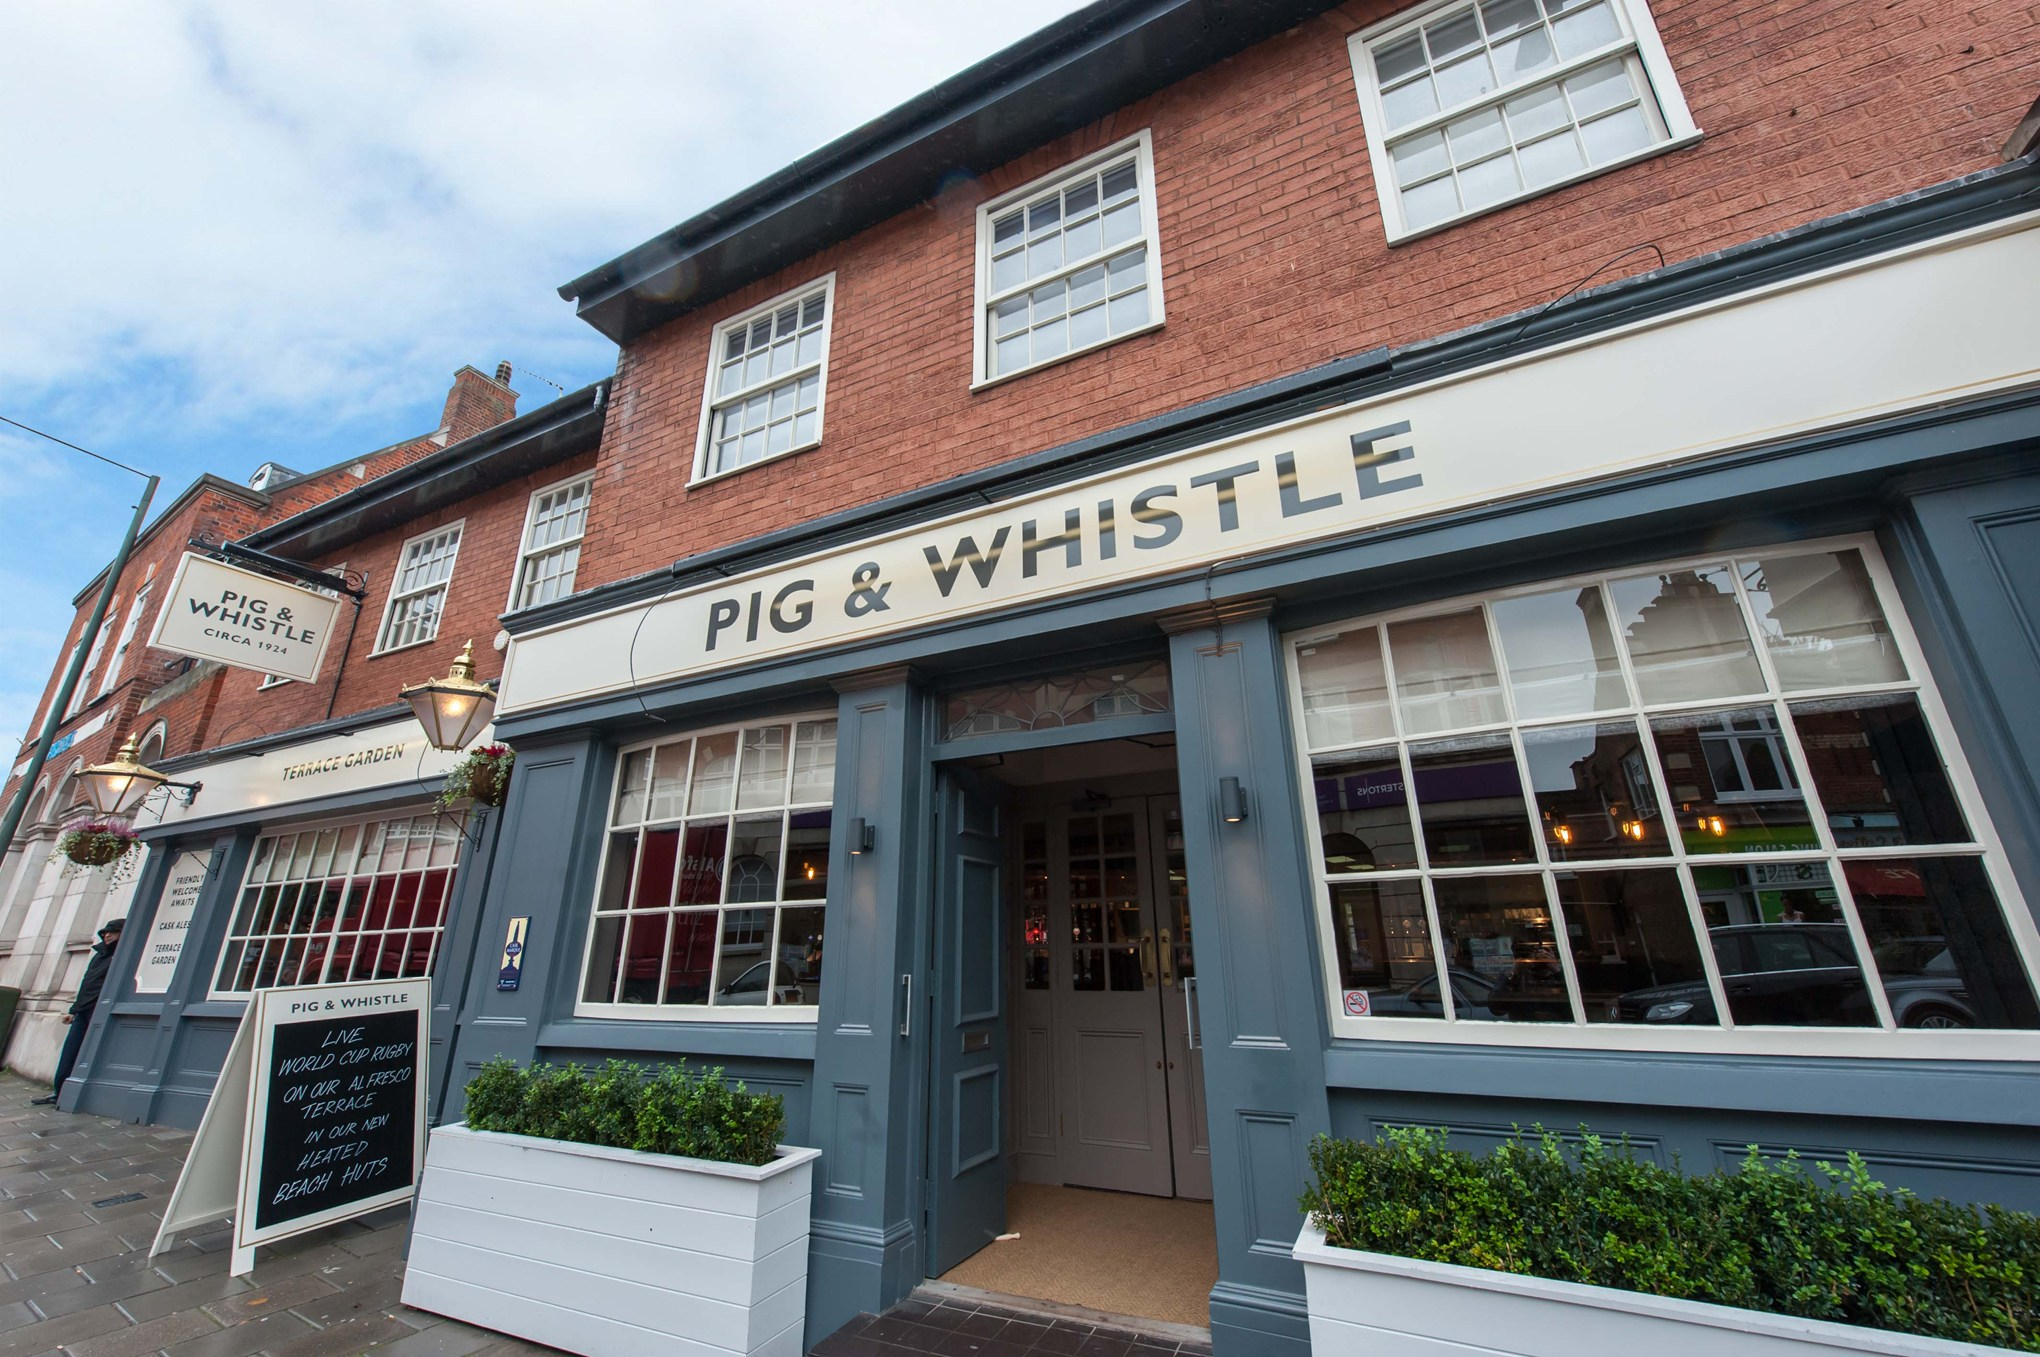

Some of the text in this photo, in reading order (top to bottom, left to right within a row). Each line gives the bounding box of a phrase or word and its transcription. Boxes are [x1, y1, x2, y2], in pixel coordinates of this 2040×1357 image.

[704, 418, 1425, 652] PIG & WHISTLE
[220, 590, 295, 622] PIG &
[189, 598, 316, 645] WHISTLE
[203, 628, 287, 655] CIRCA 1924
[282, 743, 406, 781] TERRACE GARDEN
[172, 887, 202, 896] WELCOME
[176, 875, 205, 885] FRIENDLY
[171, 898, 195, 907] AWAITS
[159, 920, 192, 931] CASK ALES
[151, 955, 177, 965] GARDEN
[155, 943, 182, 953] TERRACE
[291, 993, 409, 1013] PIG & WHISTLE
[321, 1026, 366, 1048] LIVE
[278, 1042, 413, 1077] WORLD CUP RUGBY
[283, 1083, 306, 1103] ON
[310, 1079, 340, 1099] OUR
[300, 1091, 378, 1120] TERRACE
[304, 1113, 390, 1144] IN OUR NEW
[296, 1140, 369, 1171] HEATED
[272, 1157, 388, 1206] BEACH HUTS
